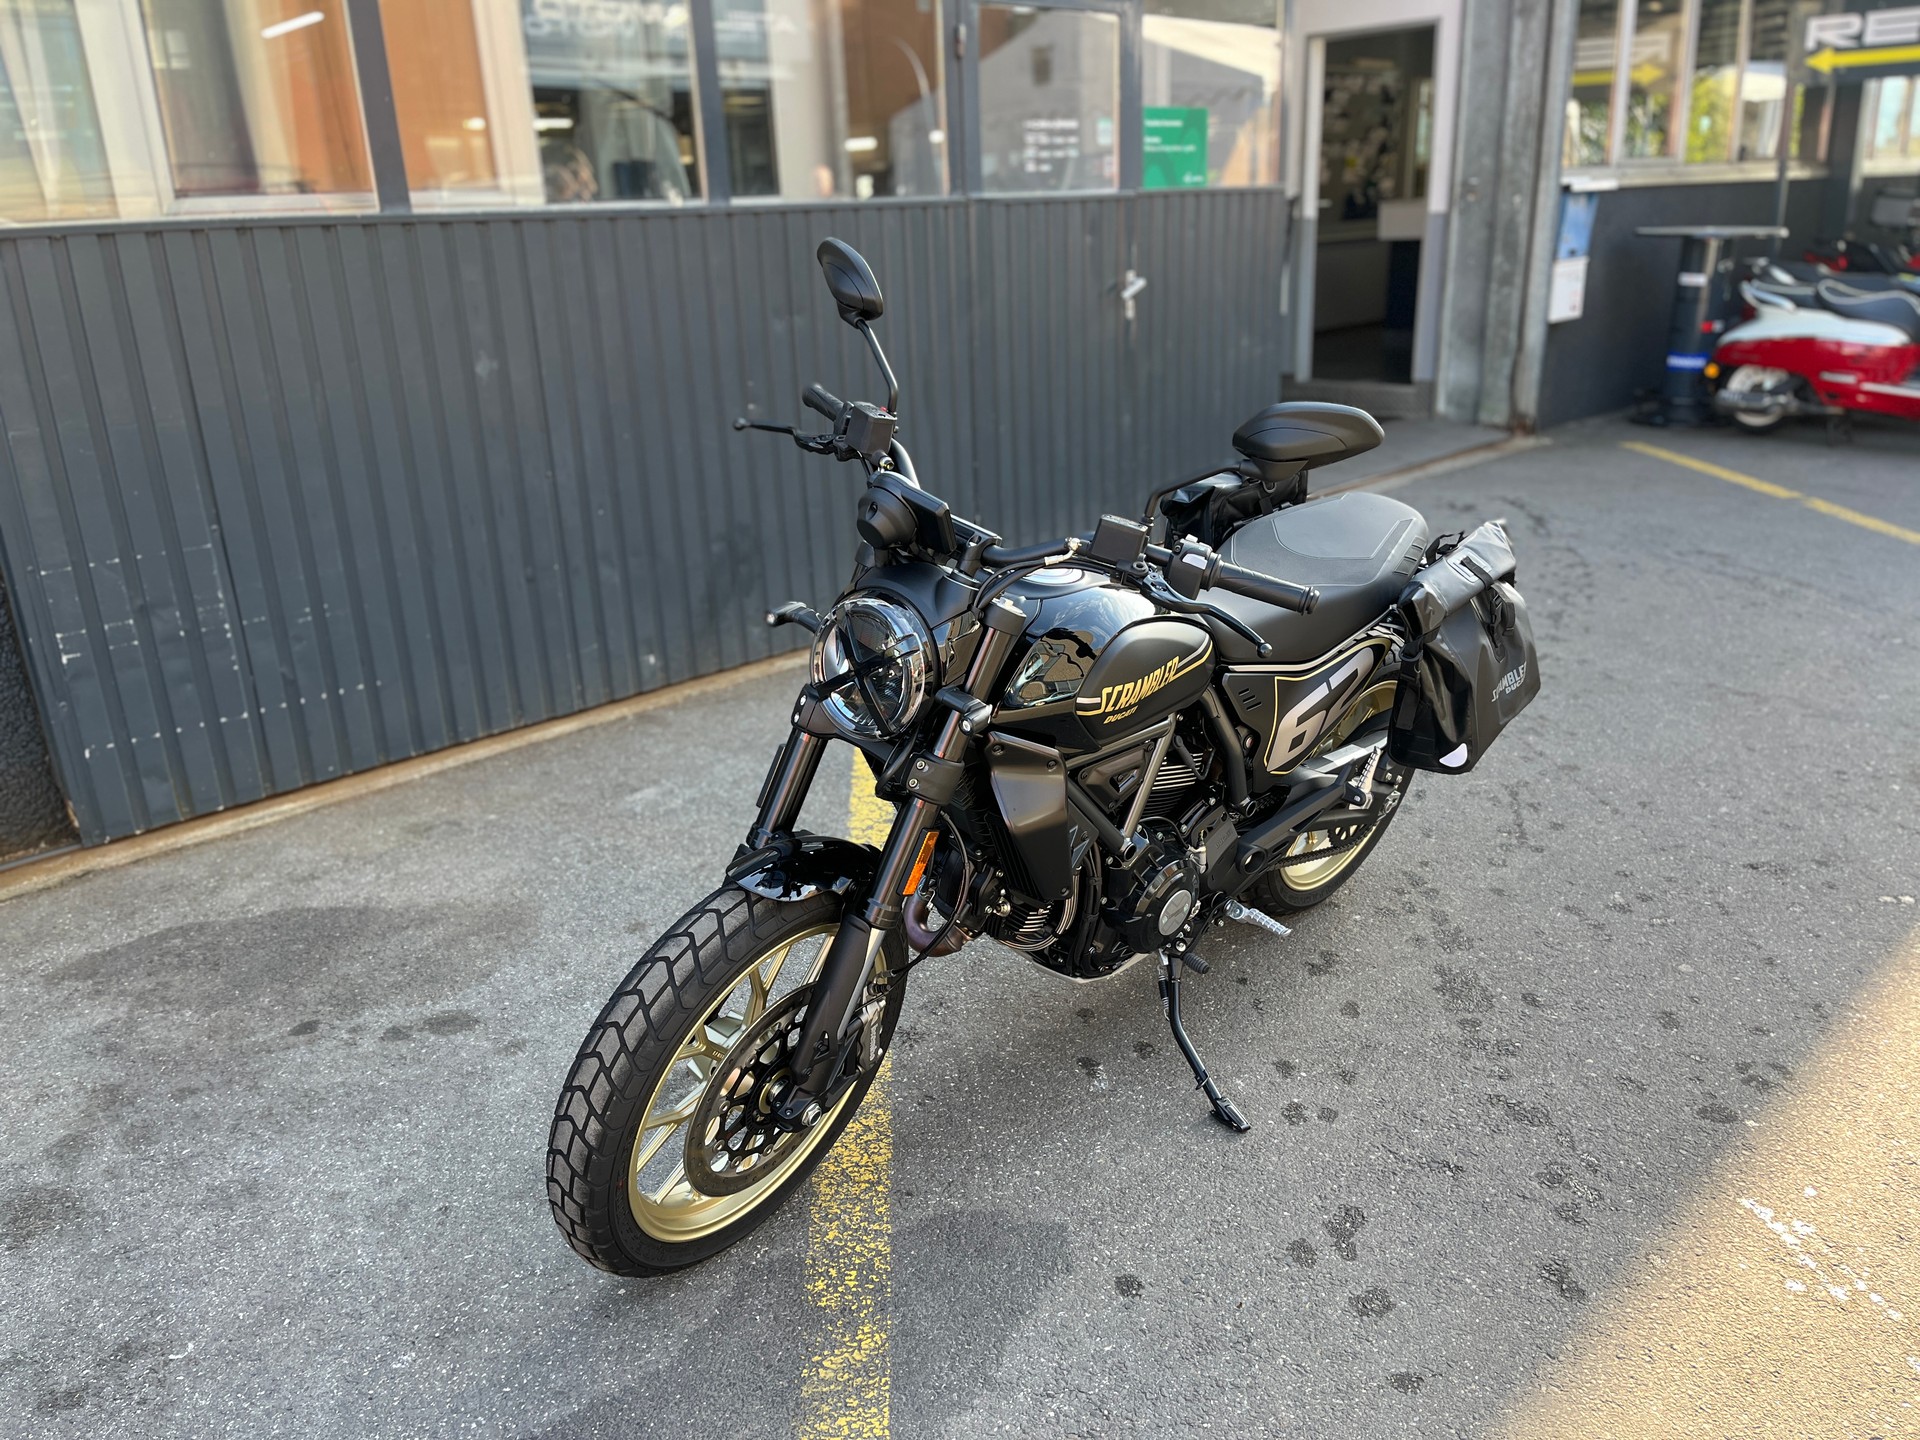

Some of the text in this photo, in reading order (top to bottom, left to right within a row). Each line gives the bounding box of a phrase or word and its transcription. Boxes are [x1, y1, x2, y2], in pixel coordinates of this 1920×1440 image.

[1100, 655, 1180, 716] SCRAMBLER
[1103, 704, 1138, 725] DUCATI
[1266, 646, 1374, 772] 62
